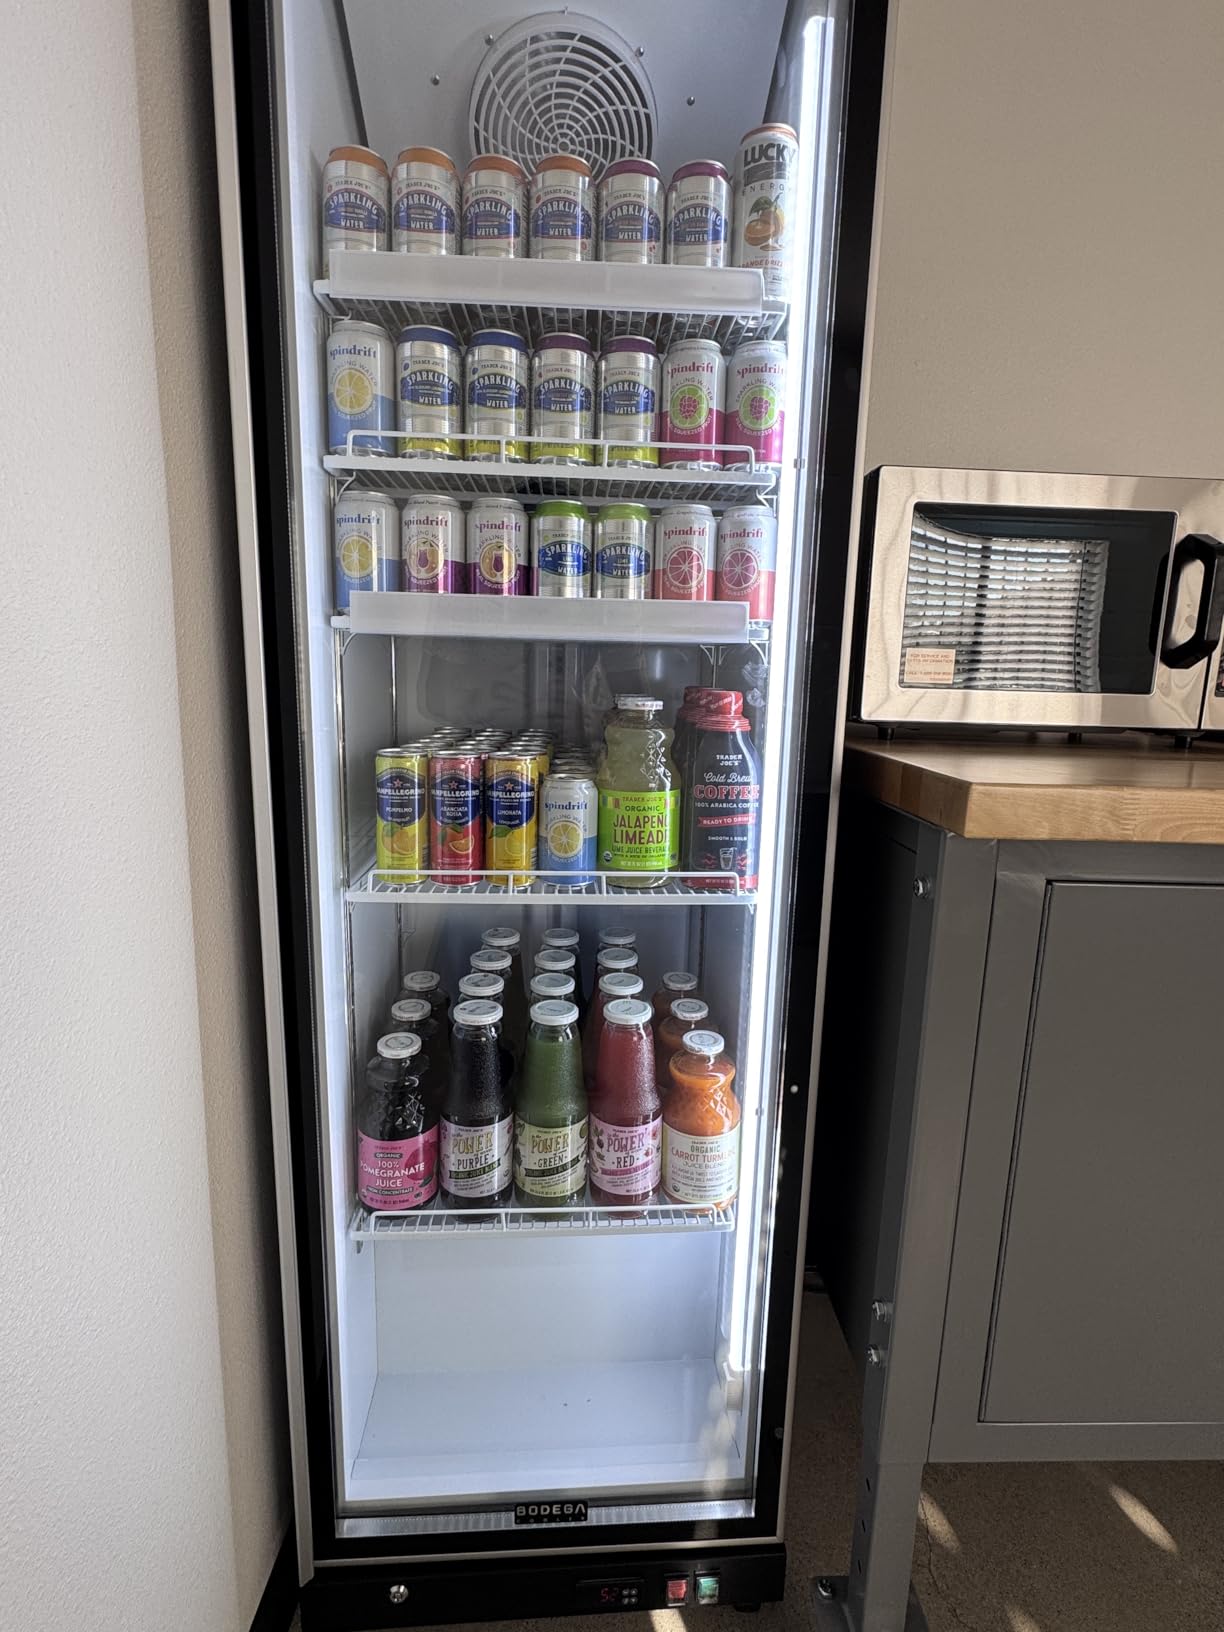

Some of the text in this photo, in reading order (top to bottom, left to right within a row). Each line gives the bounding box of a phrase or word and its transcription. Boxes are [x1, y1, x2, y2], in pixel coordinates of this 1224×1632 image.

[329, 192, 379, 214] SPARKLING
[399, 193, 447, 215] SPARKLING
[538, 200, 585, 220] SPARKLING
[466, 201, 512, 220] SPARKLING
[607, 204, 654, 223] SPARKLING
[674, 207, 721, 226] SPARKLING
[340, 218, 364, 229] WATER
[411, 220, 434, 229] WATER
[477, 227, 499, 236] WATER
[549, 227, 572, 236] WATER
[618, 231, 641, 240] WATER
[685, 234, 708, 242] WATER
[329, 344, 377, 360] spindrift
[667, 362, 713, 378] spindrift
[406, 371, 454, 390] SPARKLING
[475, 374, 521, 393] SPARKLING
[540, 378, 585, 396] SPARKLING
[604, 382, 649, 398] SPARKLING
[418, 396, 442, 405] WATER
[486, 399, 508, 408] WATER
[550, 403, 572, 411] WATER
[614, 406, 636, 414] WATER
[404, 515, 448, 529] spindrift
[546, 543, 588, 559] SPARKLING
[602, 546, 645, 563] SPARKLING
[612, 569, 633, 577] WATER
[704, 772, 752, 783] Cold Brew
[693, 784, 760, 800] COFFEE
[544, 801, 588, 811] spindrift
[626, 846, 642, 854] JUICE
[452, 1131, 493, 1155] POWER
[531, 1132, 569, 1154] POWER
[607, 1132, 645, 1153] POWER
[690, 1144, 720, 1154] ORGANIC
[537, 1153, 564, 1168] GREEN
[671, 1146, 700, 1162] CARROT
[378, 1160, 400, 1168] 100%
[457, 1153, 490, 1170] PURPLE
[616, 1155, 635, 1169] RED
[683, 1160, 703, 1169] JUICE
[375, 1178, 403, 1187] JUICE
[516, 1503, 586, 1516] BODEGA
